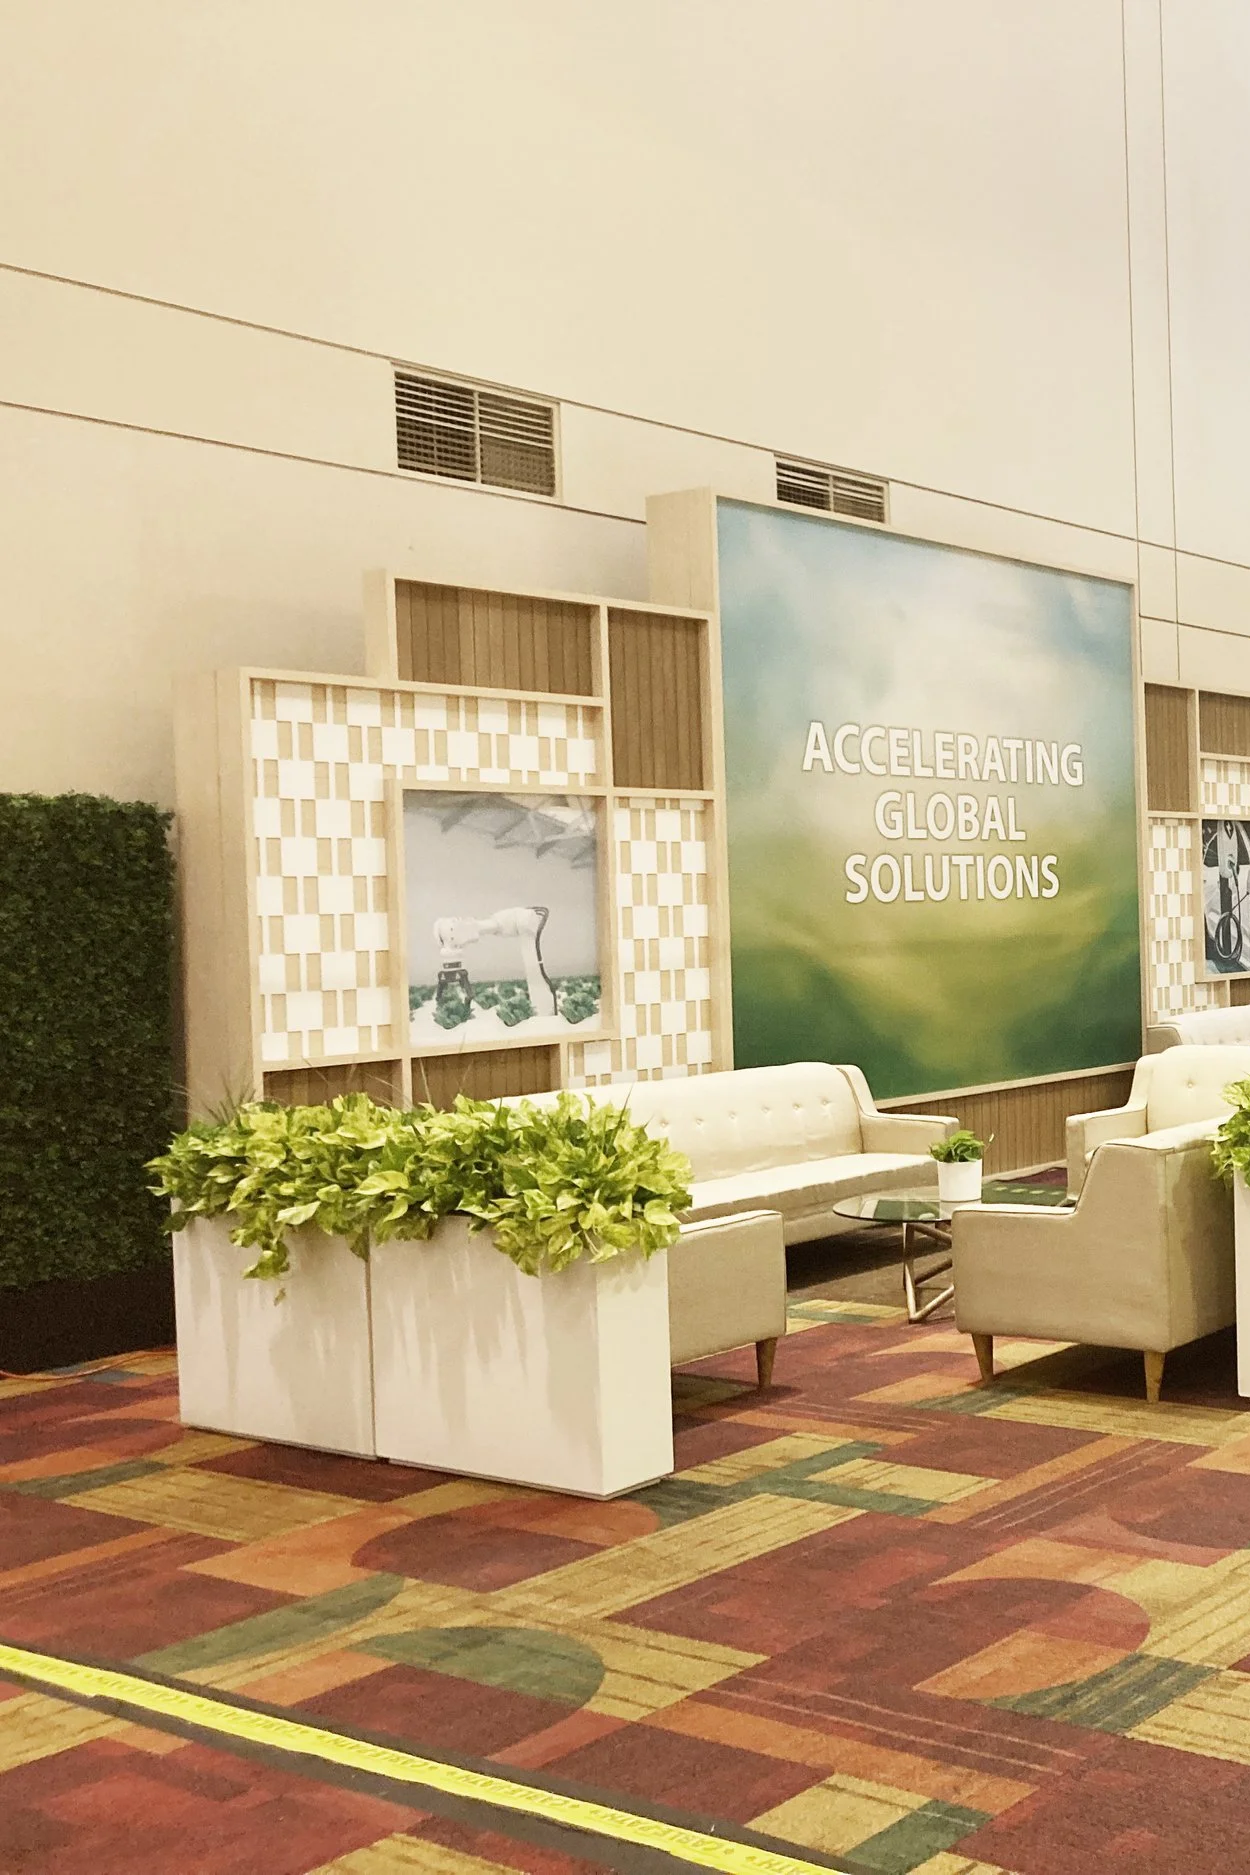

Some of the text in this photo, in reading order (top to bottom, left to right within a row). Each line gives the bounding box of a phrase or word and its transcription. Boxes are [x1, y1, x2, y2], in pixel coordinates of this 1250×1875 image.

[802, 720, 1084, 787] ACCELERATING
[875, 791, 1027, 841] GLOBAL
[845, 853, 1060, 904] SOLUTIONS
